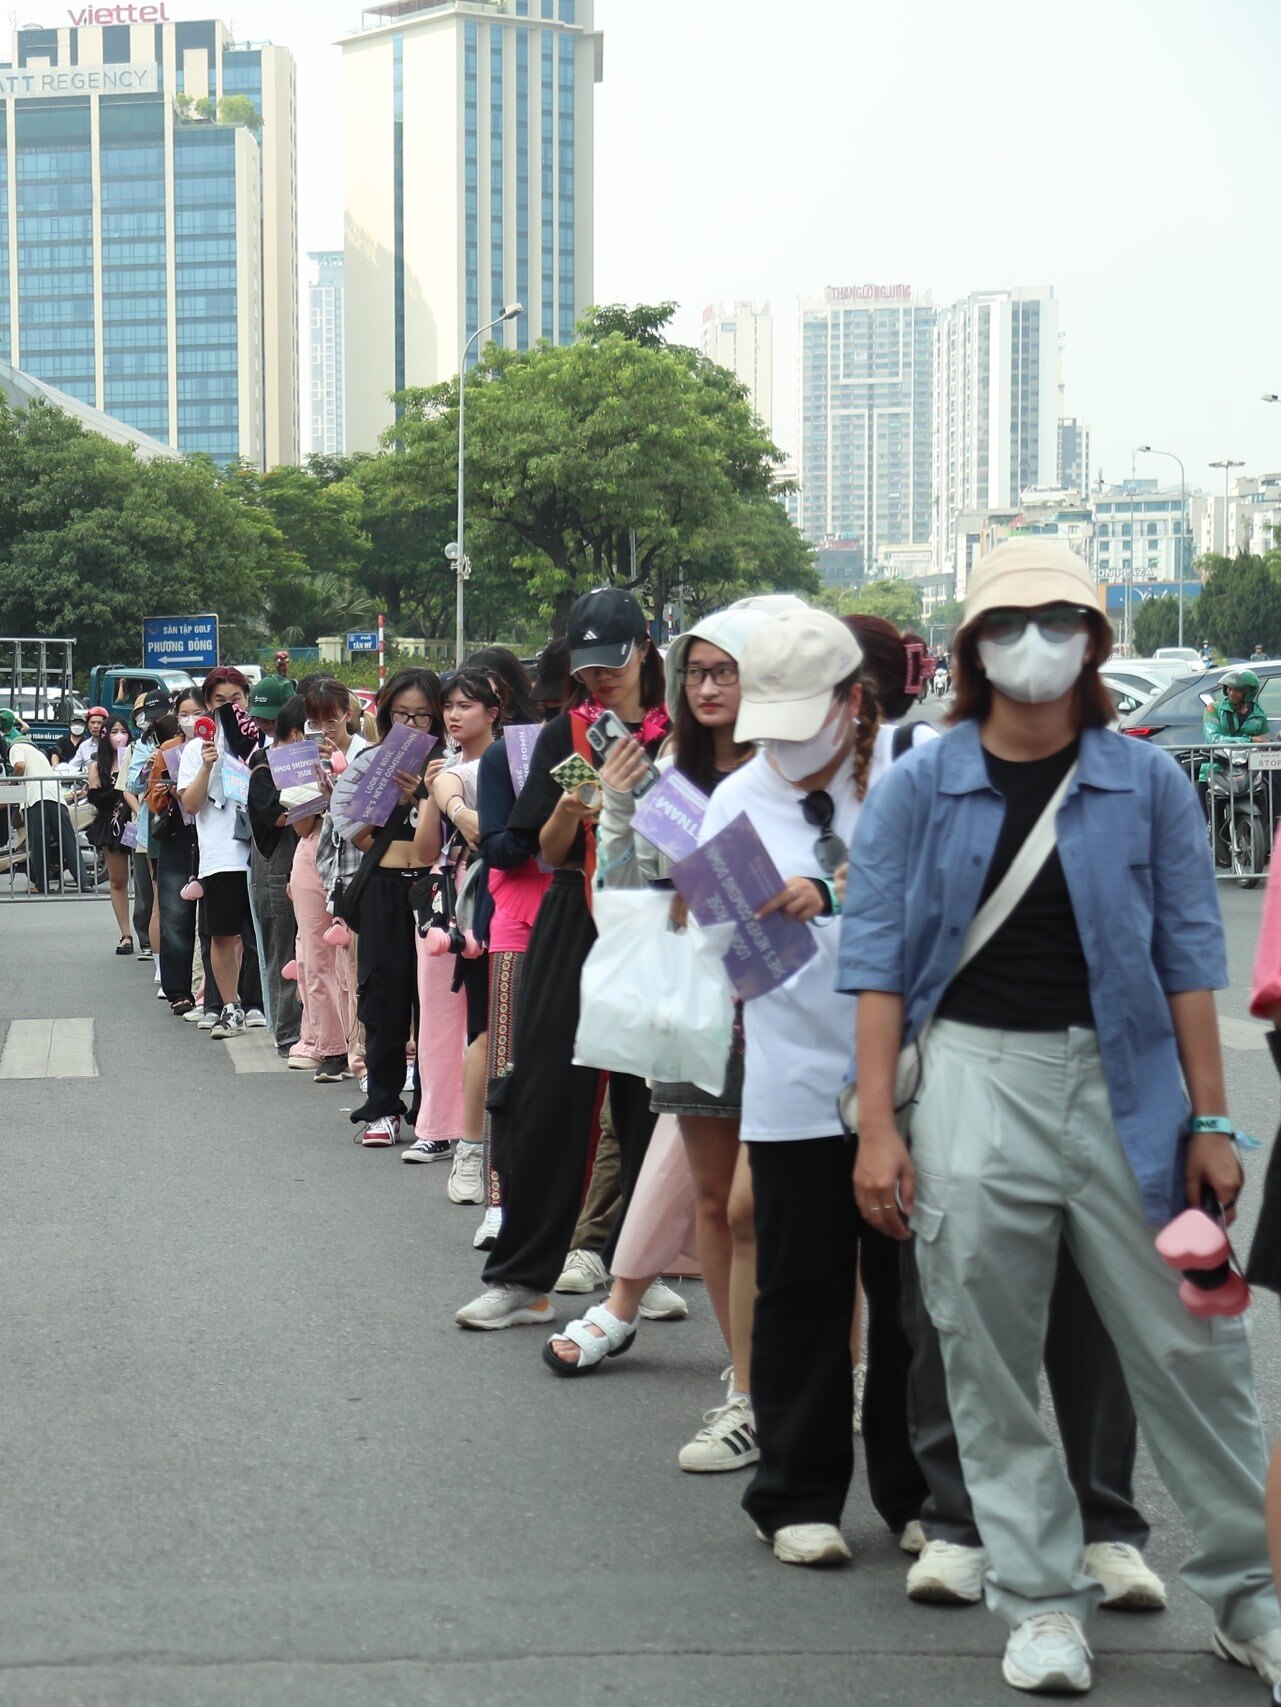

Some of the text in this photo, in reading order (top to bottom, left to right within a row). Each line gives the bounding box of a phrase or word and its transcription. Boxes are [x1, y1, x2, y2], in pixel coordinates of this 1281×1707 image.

[67, 2, 170, 26] viettel
[41, 69, 148, 92] REGENCY
[194, 625, 212, 634] GOLF
[147, 640, 184, 653] PHƯƠNG
[518, 731, 528, 761] DOWN
[274, 759, 315, 775] COMING DOWN
[362, 799, 377, 819] SHE'S
[373, 776, 390, 800] NEVER
[384, 750, 406, 779] COMING
[401, 732, 418, 751] DOWN
[365, 776, 379, 795] LOOK
[378, 767, 385, 777] AT
[704, 846, 729, 884] DOWN
[722, 877, 756, 923] COMING
